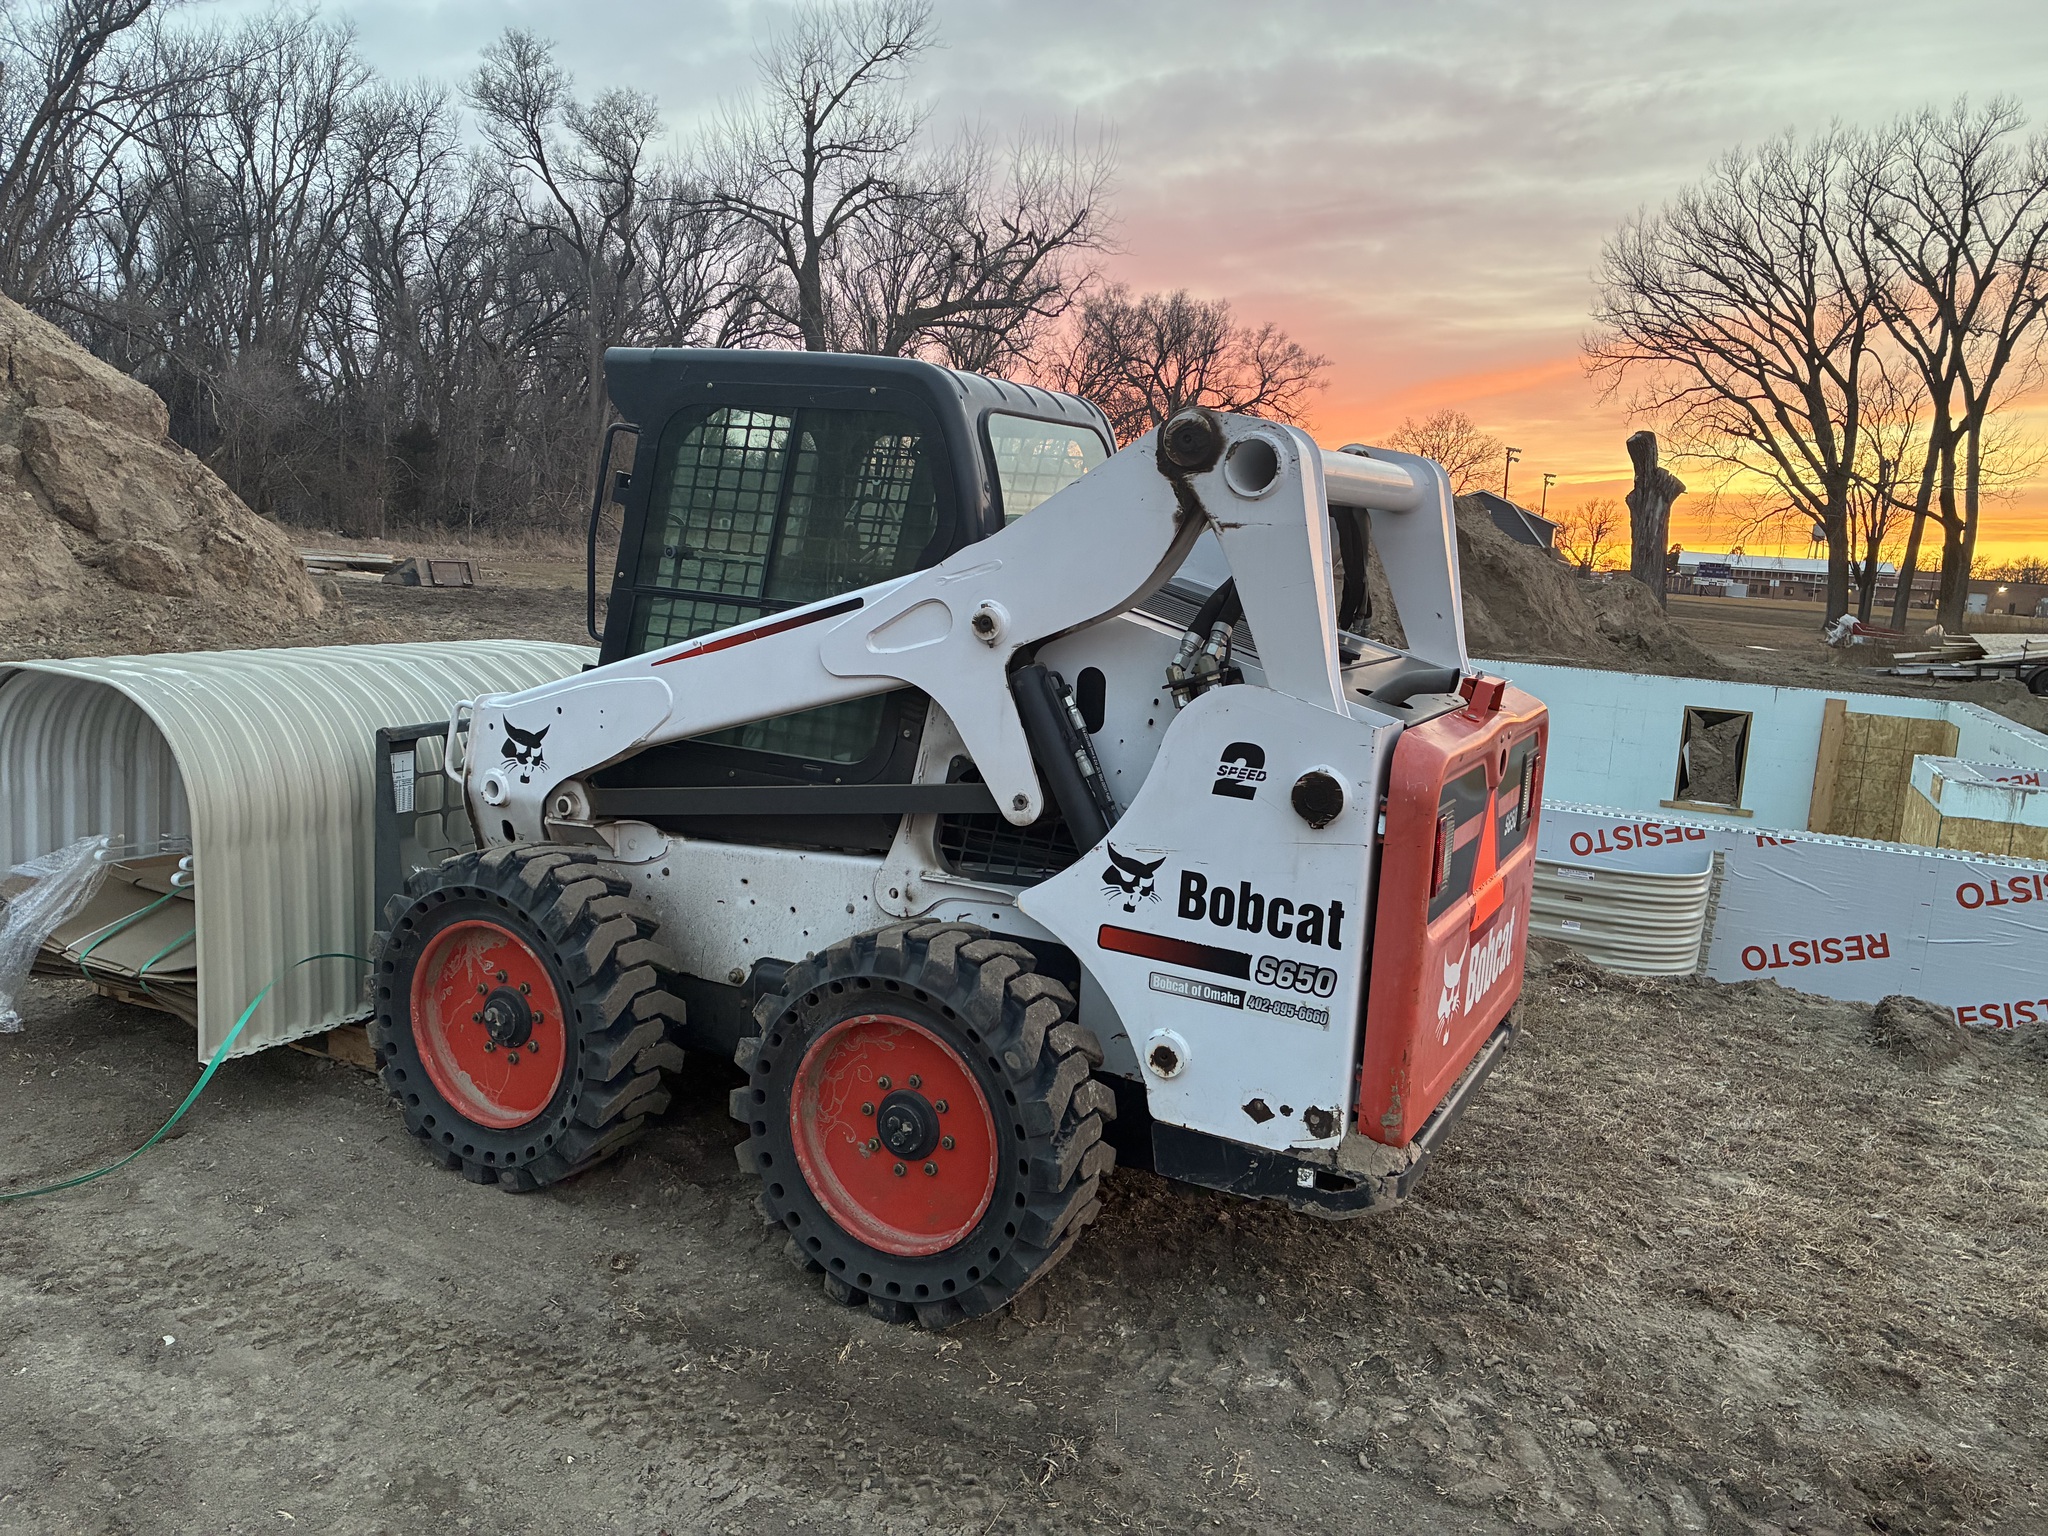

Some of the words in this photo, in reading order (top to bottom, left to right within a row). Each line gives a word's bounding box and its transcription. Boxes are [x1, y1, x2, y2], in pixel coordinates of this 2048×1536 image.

[1216, 764, 1268, 782] SPEED
[1177, 869, 1345, 950] Bobcat
[1956, 873, 2048, 910] ISTO
[1463, 905, 1516, 1018] Bobcat
[1741, 932, 1890, 972] RESISTO
[1152, 974, 1189, 996] Bobcat
[1191, 984, 1202, 997] of
[1203, 985, 1240, 1006] Omaha
[1254, 955, 1338, 998] S650
[1246, 995, 1330, 1026] 402-895-6660
